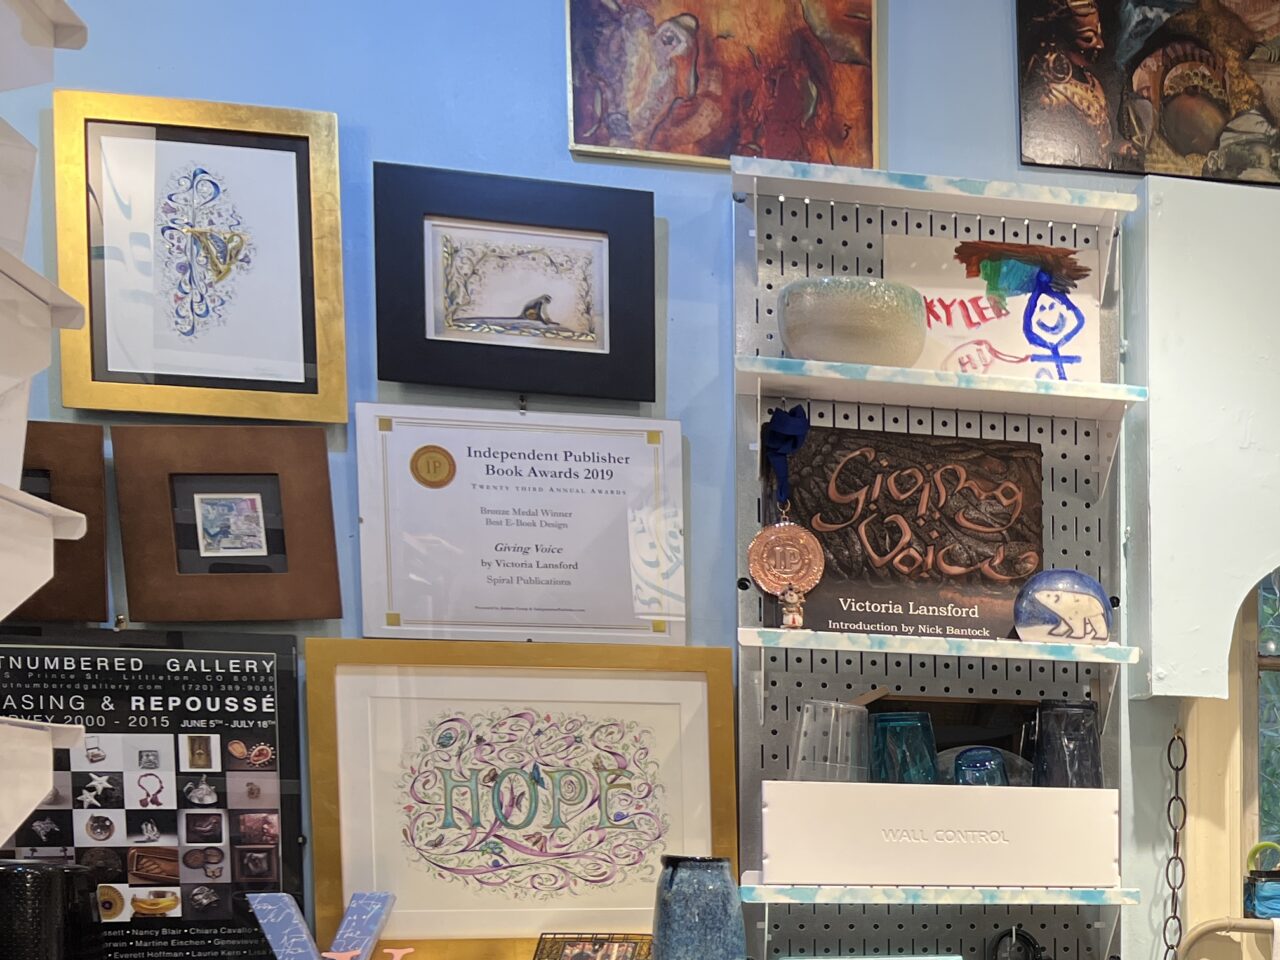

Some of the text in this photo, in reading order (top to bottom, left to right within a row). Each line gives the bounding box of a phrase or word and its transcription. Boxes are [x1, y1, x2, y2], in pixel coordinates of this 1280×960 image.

[467, 446, 631, 466] Independent Publisher
[485, 464, 614, 482] Book Awards 2019
[512, 508, 538, 517] Medal
[541, 510, 573, 519] Winner
[485, 518, 569, 531] Best E-Book Design
[494, 543, 564, 555] Giving Voice
[481, 559, 579, 570] by Victoria Lansford
[486, 575, 572, 586] Spiral Publications
[838, 598, 979, 619] Victoria Lansford
[828, 620, 990, 638] Introduction by Nick Bantock
[166, 658, 275, 673] GALLERY
[28, 672, 76, 680] Prince
[101, 696, 116, 711] &
[131, 694, 276, 713] REPOUSSÉ
[64, 715, 106, 727] 2000
[128, 716, 170, 728] 2015
[181, 719, 208, 728] JUNE
[230, 720, 255, 729] JULY
[438, 767, 638, 830] HOPE
[881, 828, 1010, 845] WALL CONTROL
[103, 929, 125, 937] ssett
[131, 928, 160, 937] Nancy
[189, 927, 219, 935] Chiara
[135, 939, 169, 947] Martine
[170, 938, 206, 947] Eischen
[113, 951, 146, 959] Everett
[146, 950, 184, 959] Hoffman
